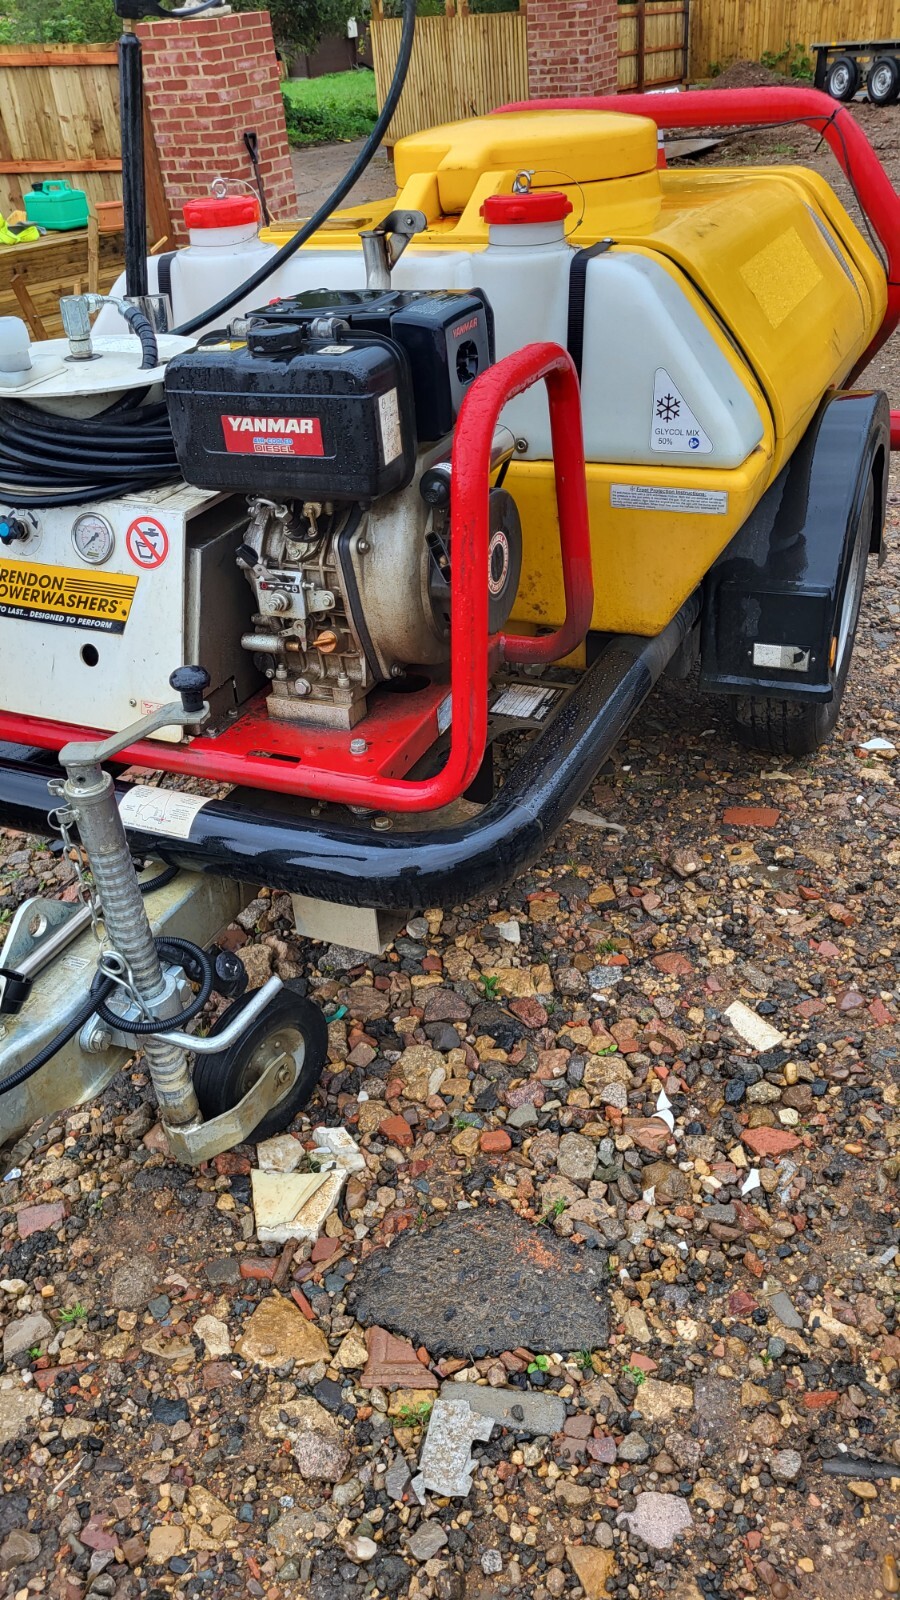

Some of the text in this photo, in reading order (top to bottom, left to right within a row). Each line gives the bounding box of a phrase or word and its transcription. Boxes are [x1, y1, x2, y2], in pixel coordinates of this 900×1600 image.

[452, 317, 478, 337] YANMAR
[228, 417, 314, 434] YANMAR
[655, 428, 684, 436] GLYCOL
[253, 437, 293, 445] AIR-COOLED
[254, 444, 295, 454] DIESEL
[30, 610, 65, 623] DESIGNED
[66, 616, 76, 624] TO
[77, 618, 113, 629] PERFORM
